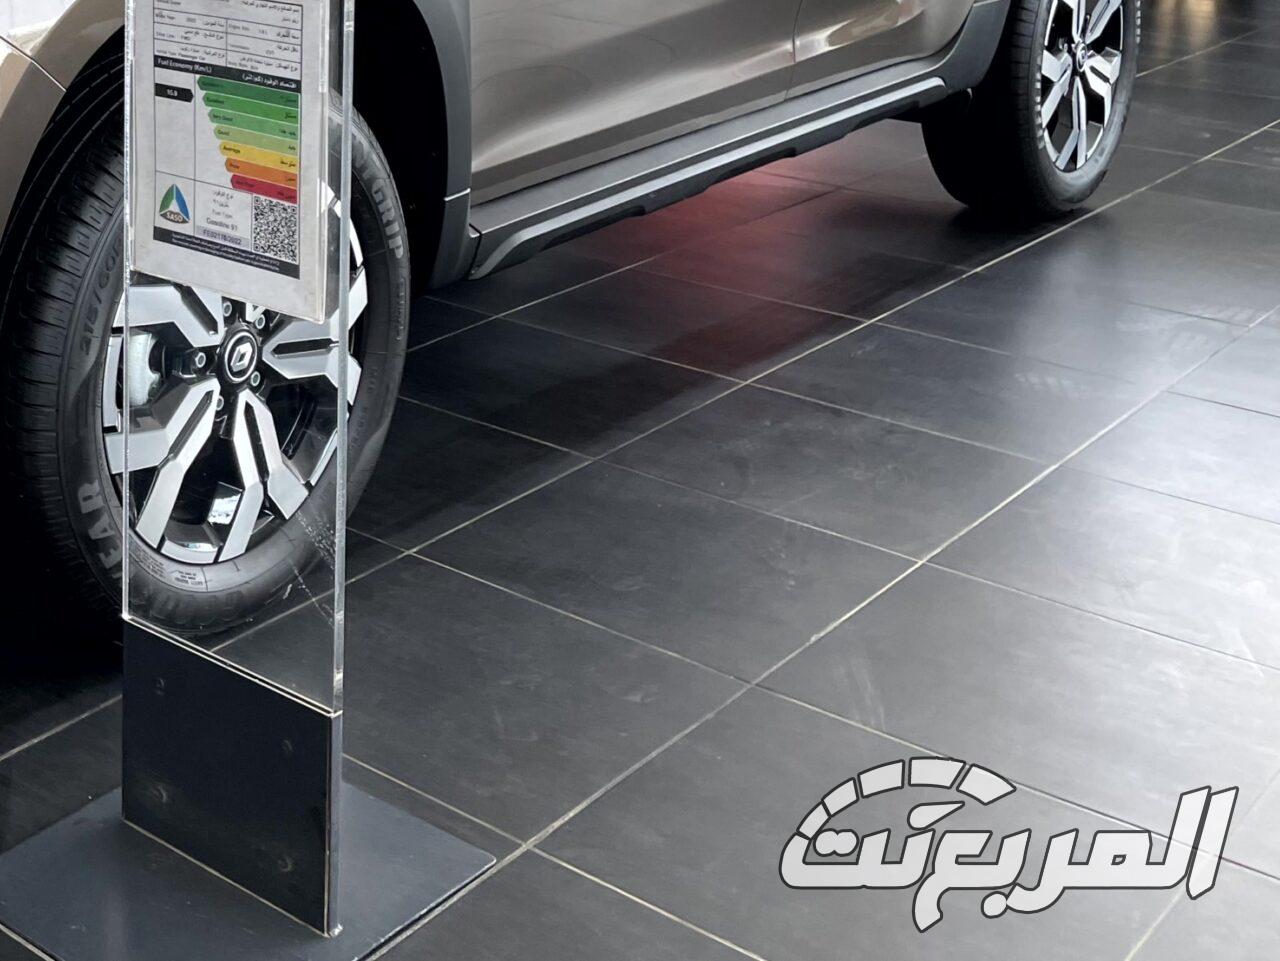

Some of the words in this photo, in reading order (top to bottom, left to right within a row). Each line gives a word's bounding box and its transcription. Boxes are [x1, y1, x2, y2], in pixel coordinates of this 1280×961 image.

[158, 58, 169, 66] Fuel
[170, 59, 193, 71] Economy
[223, 145, 241, 154] Average
[166, 211, 184, 222] SASO
[206, 216, 230, 230] Gasoline
